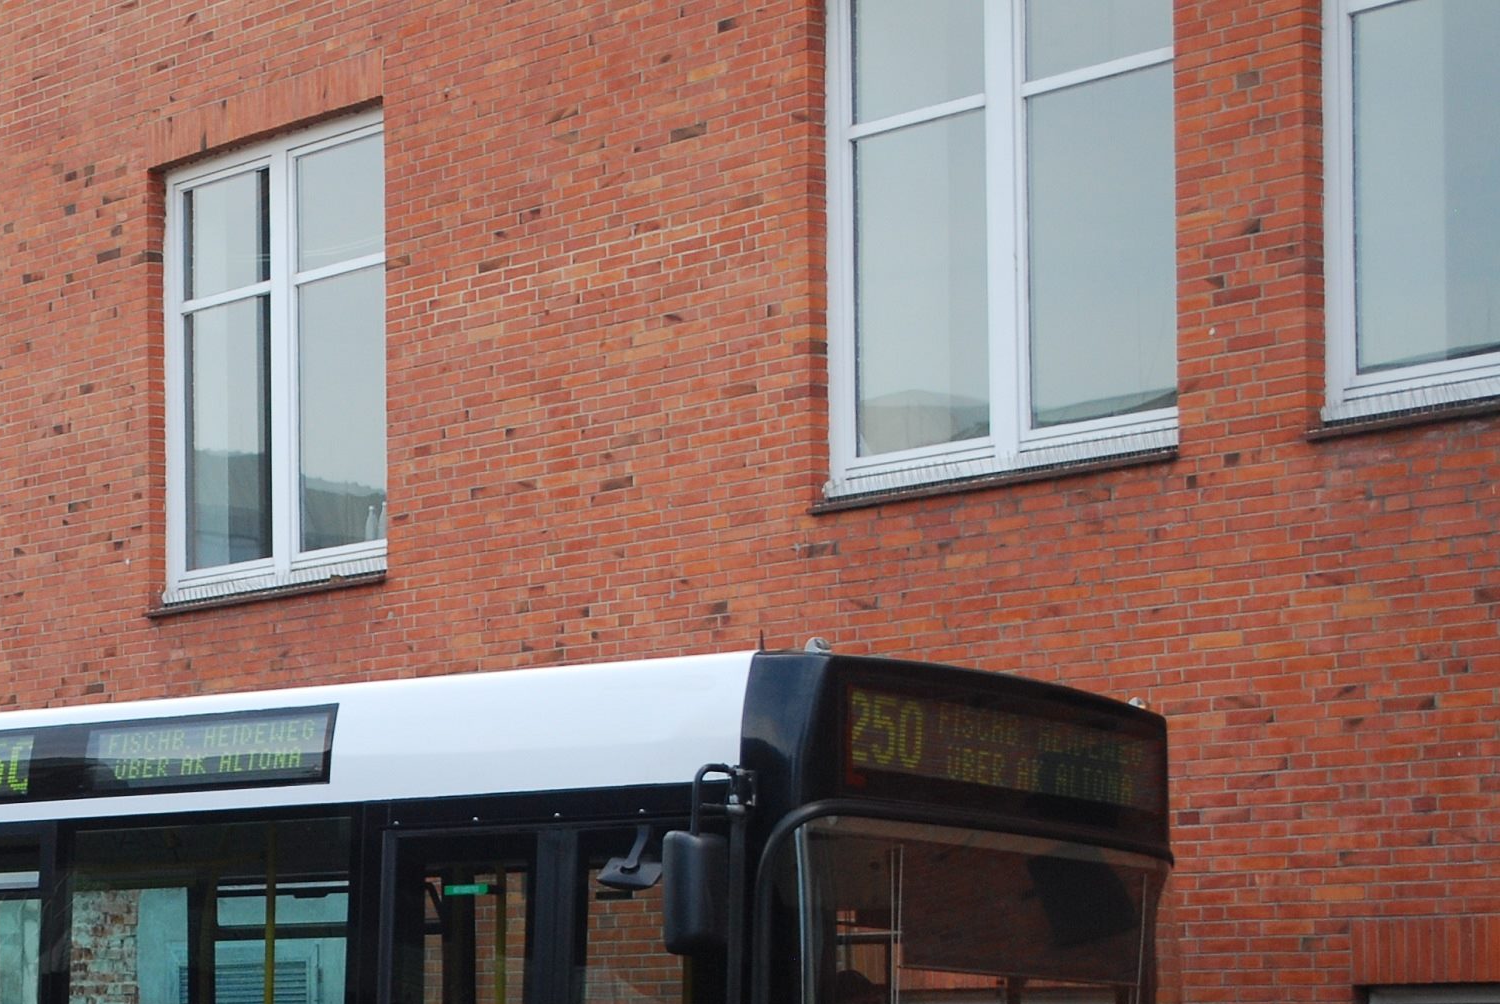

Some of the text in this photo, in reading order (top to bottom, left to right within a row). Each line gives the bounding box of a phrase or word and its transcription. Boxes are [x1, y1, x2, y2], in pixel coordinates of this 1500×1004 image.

[107, 718, 315, 755] FISCHB. HEIDEWEG
[851, 691, 924, 770] 250
[180, 754, 206, 774] AK
[219, 747, 301, 773] ALTONA
[1016, 757, 1044, 792] AK
